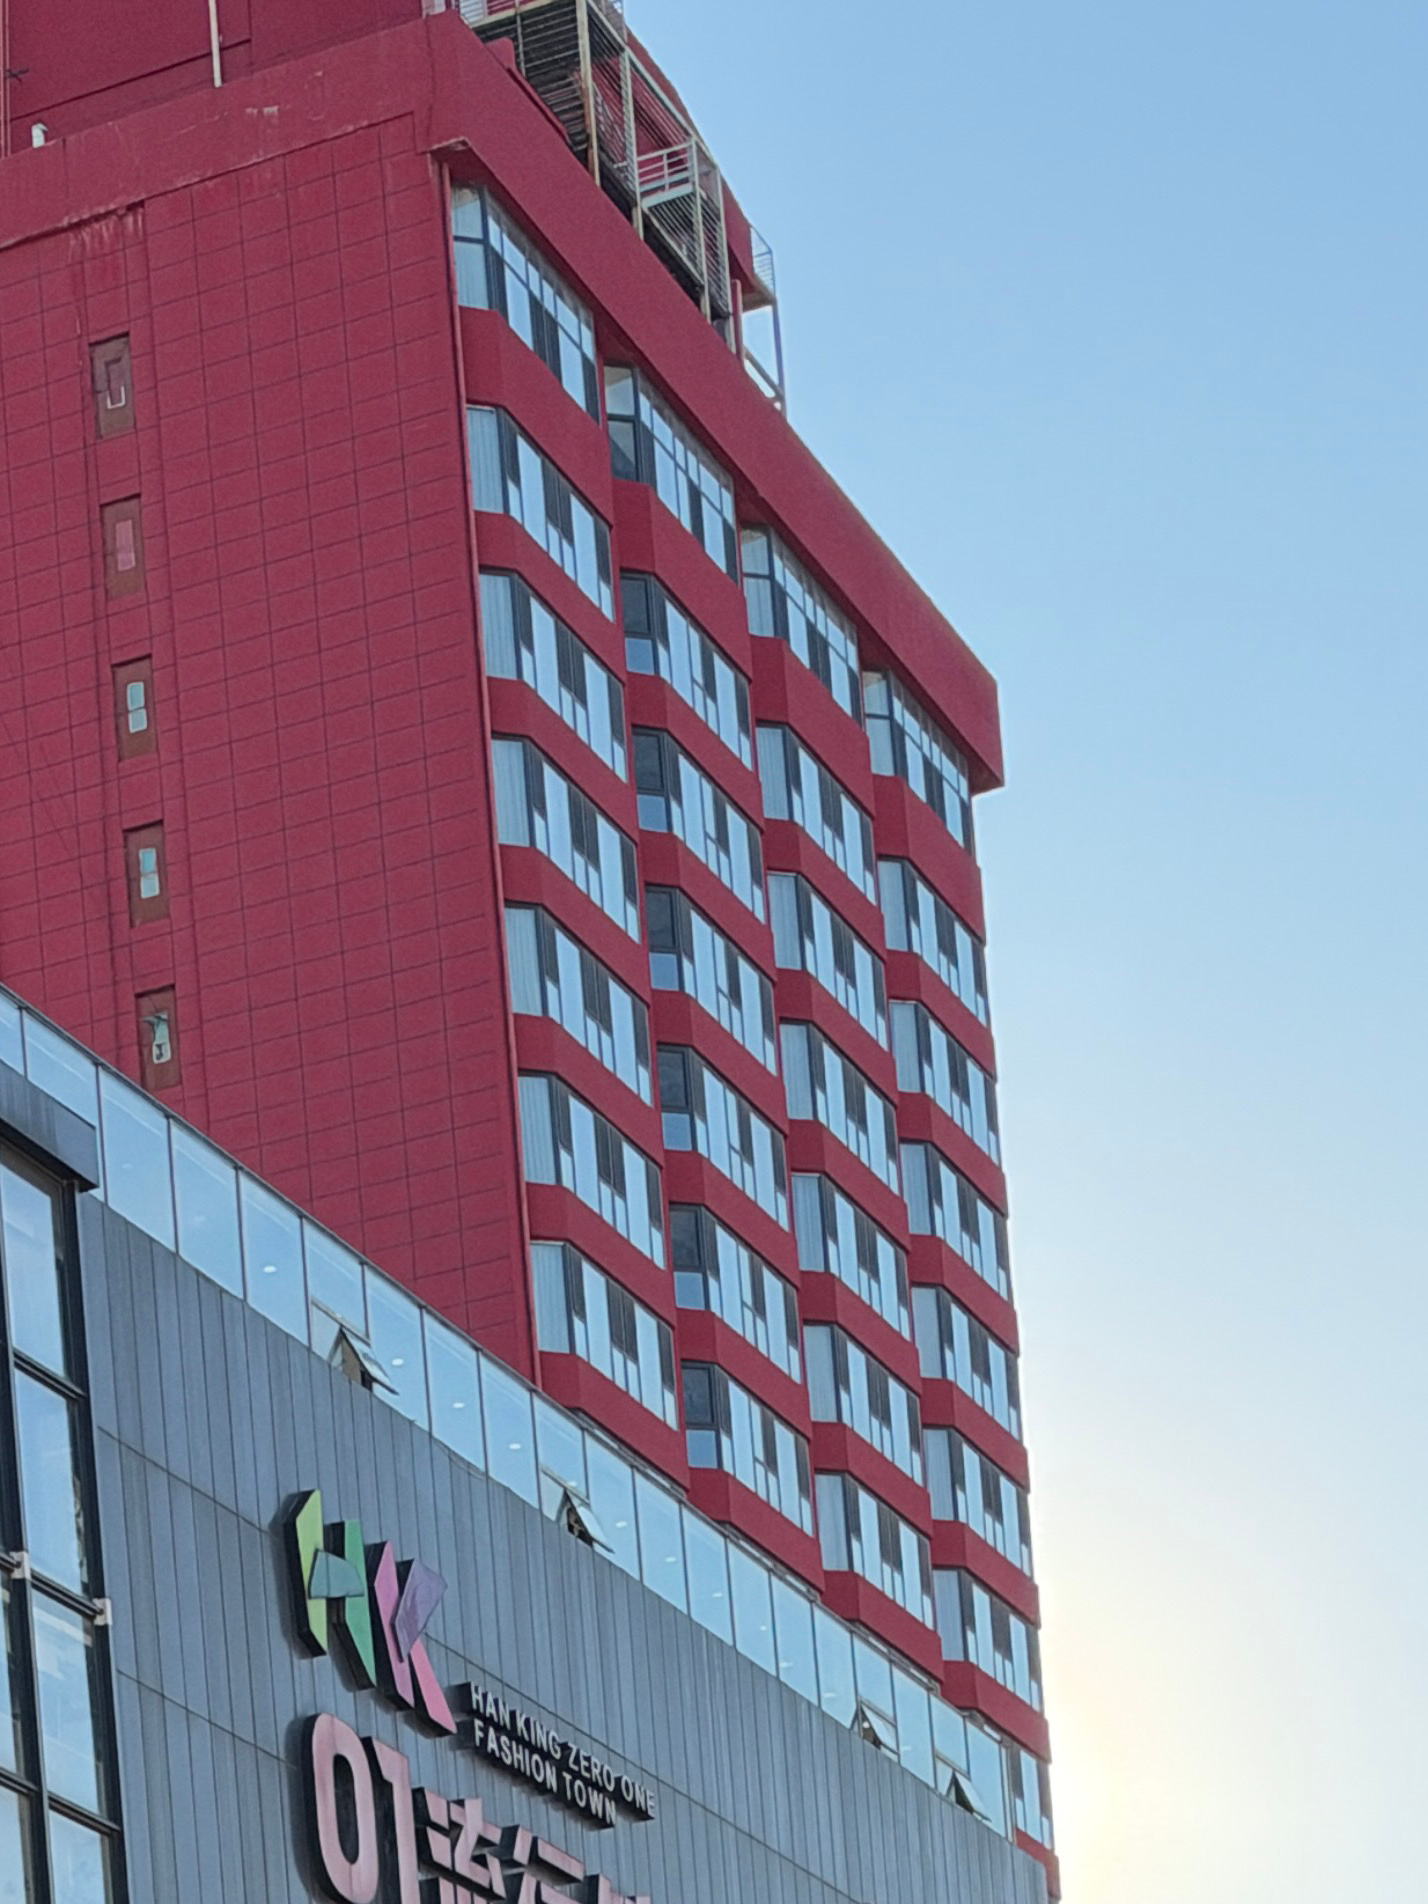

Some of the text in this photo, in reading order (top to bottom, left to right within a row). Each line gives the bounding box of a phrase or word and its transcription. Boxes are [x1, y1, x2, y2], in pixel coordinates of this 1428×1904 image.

[472, 1682, 656, 1817] HAN KING ZERO ONE
[474, 1718, 617, 1826] FASHION TOWN
